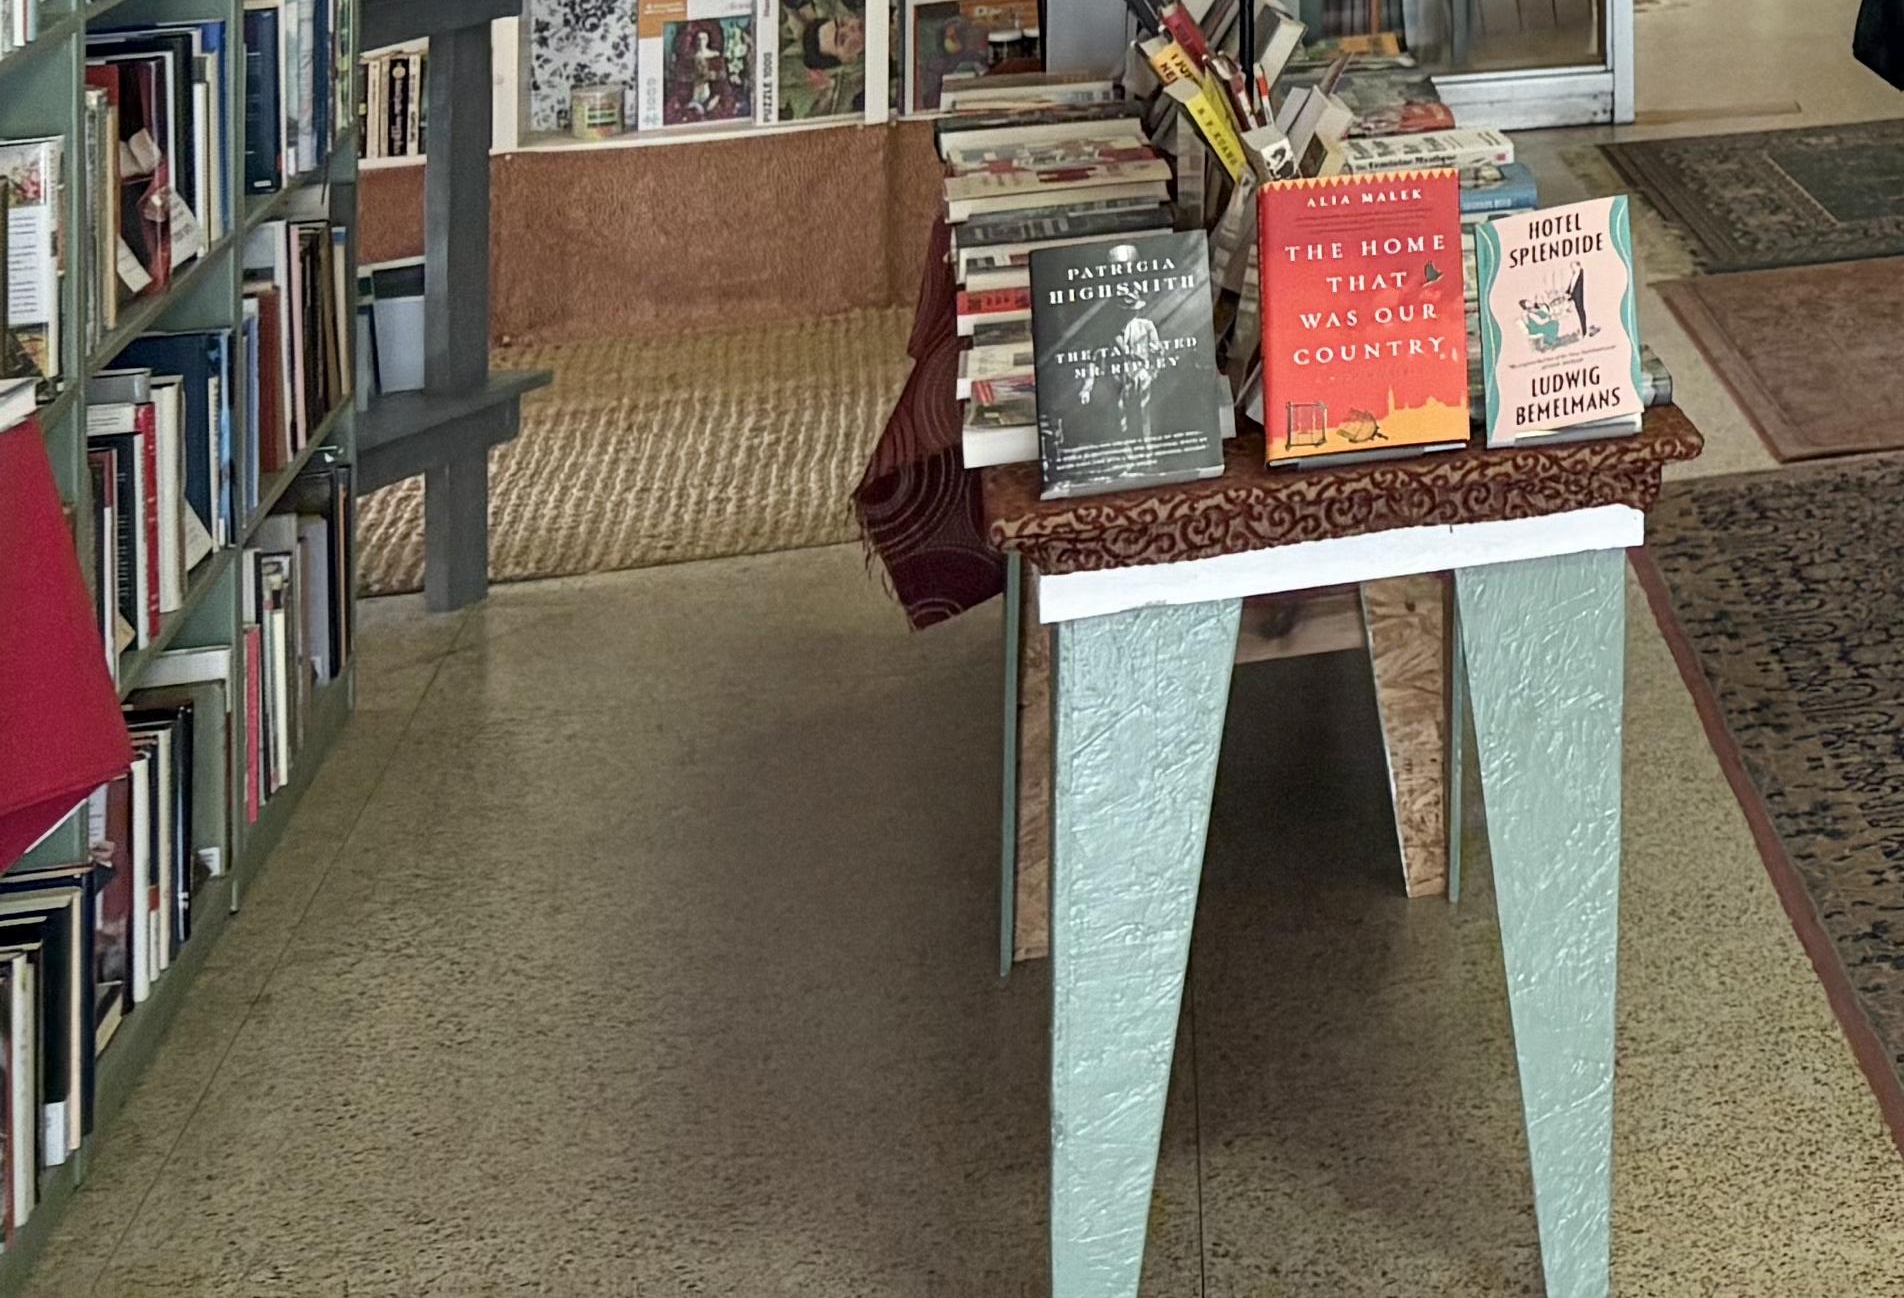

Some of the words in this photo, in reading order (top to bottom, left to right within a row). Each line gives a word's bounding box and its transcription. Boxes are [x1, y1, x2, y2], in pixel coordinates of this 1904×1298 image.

[1526, 211, 1583, 242] HOTEL
[1507, 231, 1605, 270] SPLENDIDE
[1066, 256, 1177, 282] PATRICIA
[1048, 275, 1197, 306] HIGHSMITH
[1530, 367, 1602, 399] LUDWIG
[1514, 387, 1622, 427] BEMELMANS
